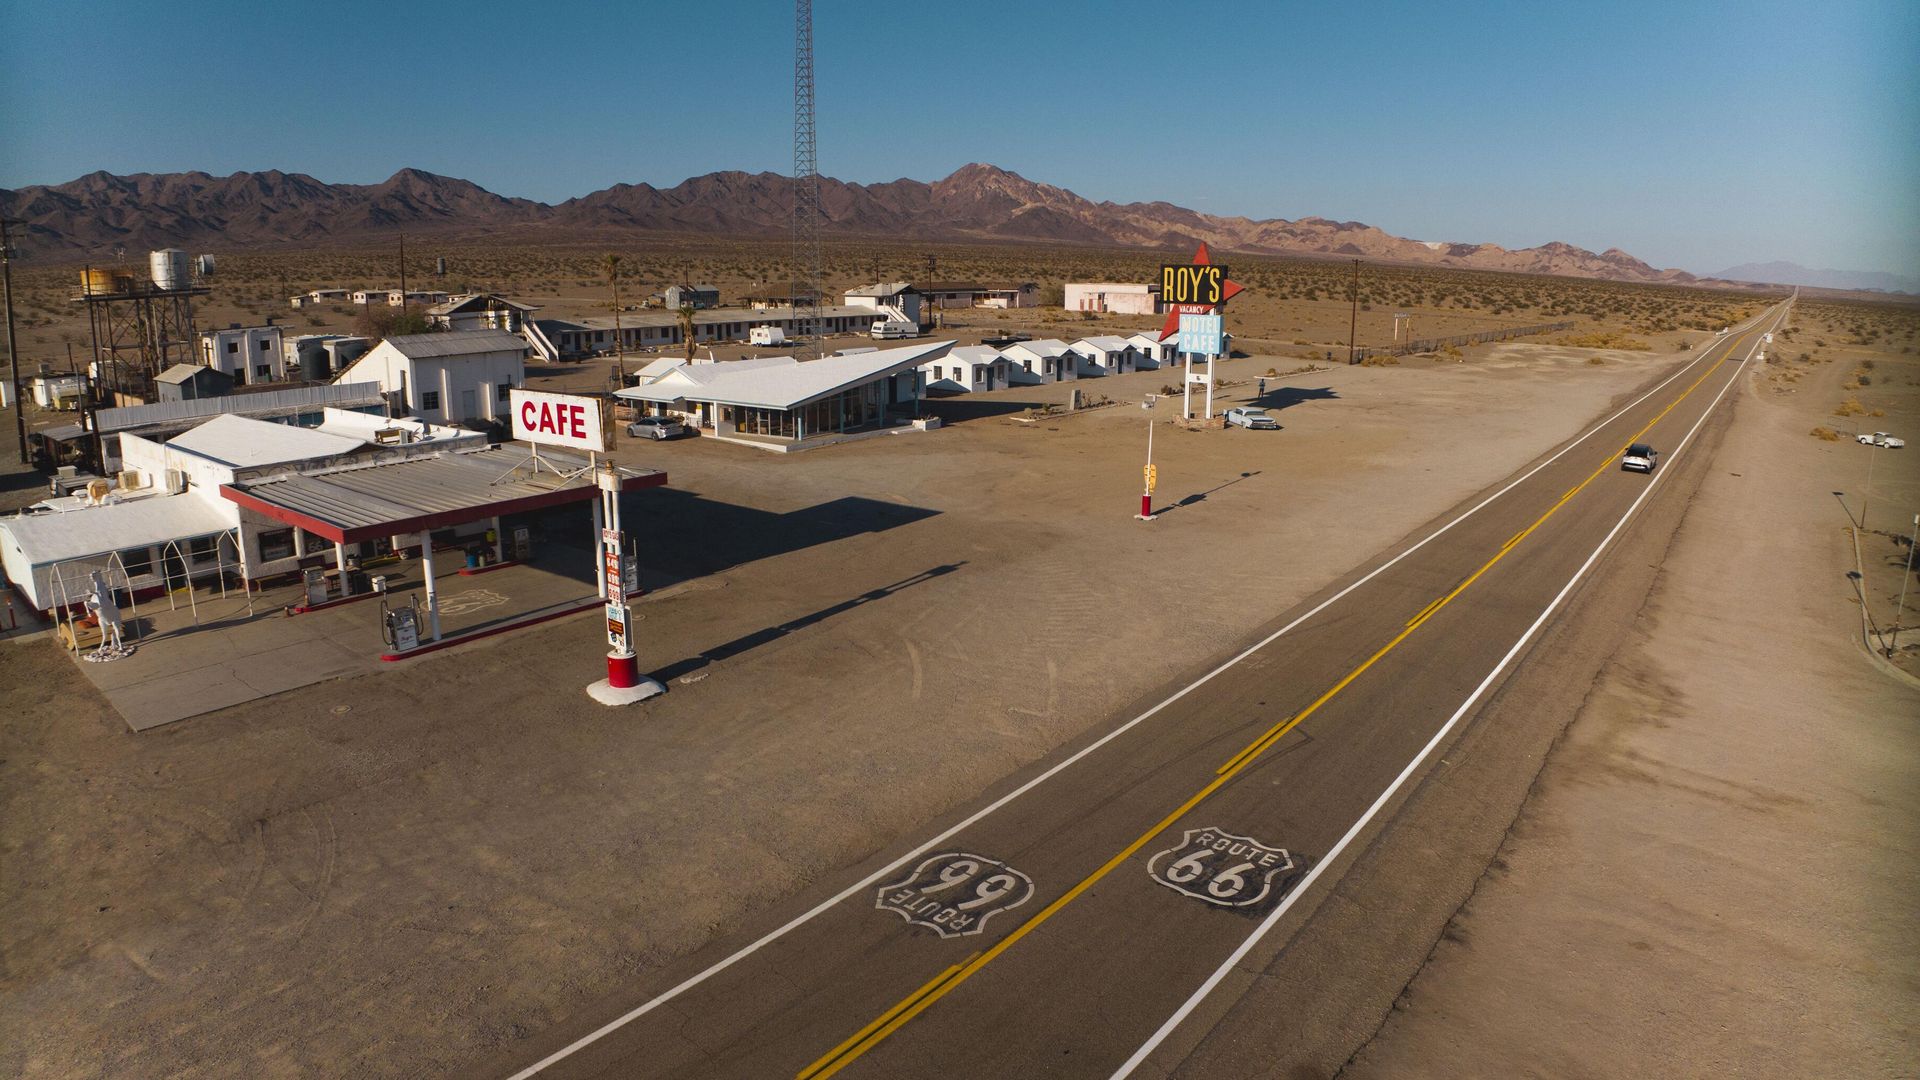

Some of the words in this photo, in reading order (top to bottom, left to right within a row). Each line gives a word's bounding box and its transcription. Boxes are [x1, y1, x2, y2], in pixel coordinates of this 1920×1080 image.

[1163, 266, 1220, 303] ROY'S
[1179, 305, 1204, 314] VACANCY
[1181, 316, 1218, 334] MOTEL
[1184, 334, 1215, 351] CAFE
[521, 401, 587, 439] CAFE
[1195, 833, 1279, 867] ROUTE
[920, 860, 1016, 911] 66
[1166, 849, 1255, 898] 66
[889, 889, 974, 931] ROUTE
